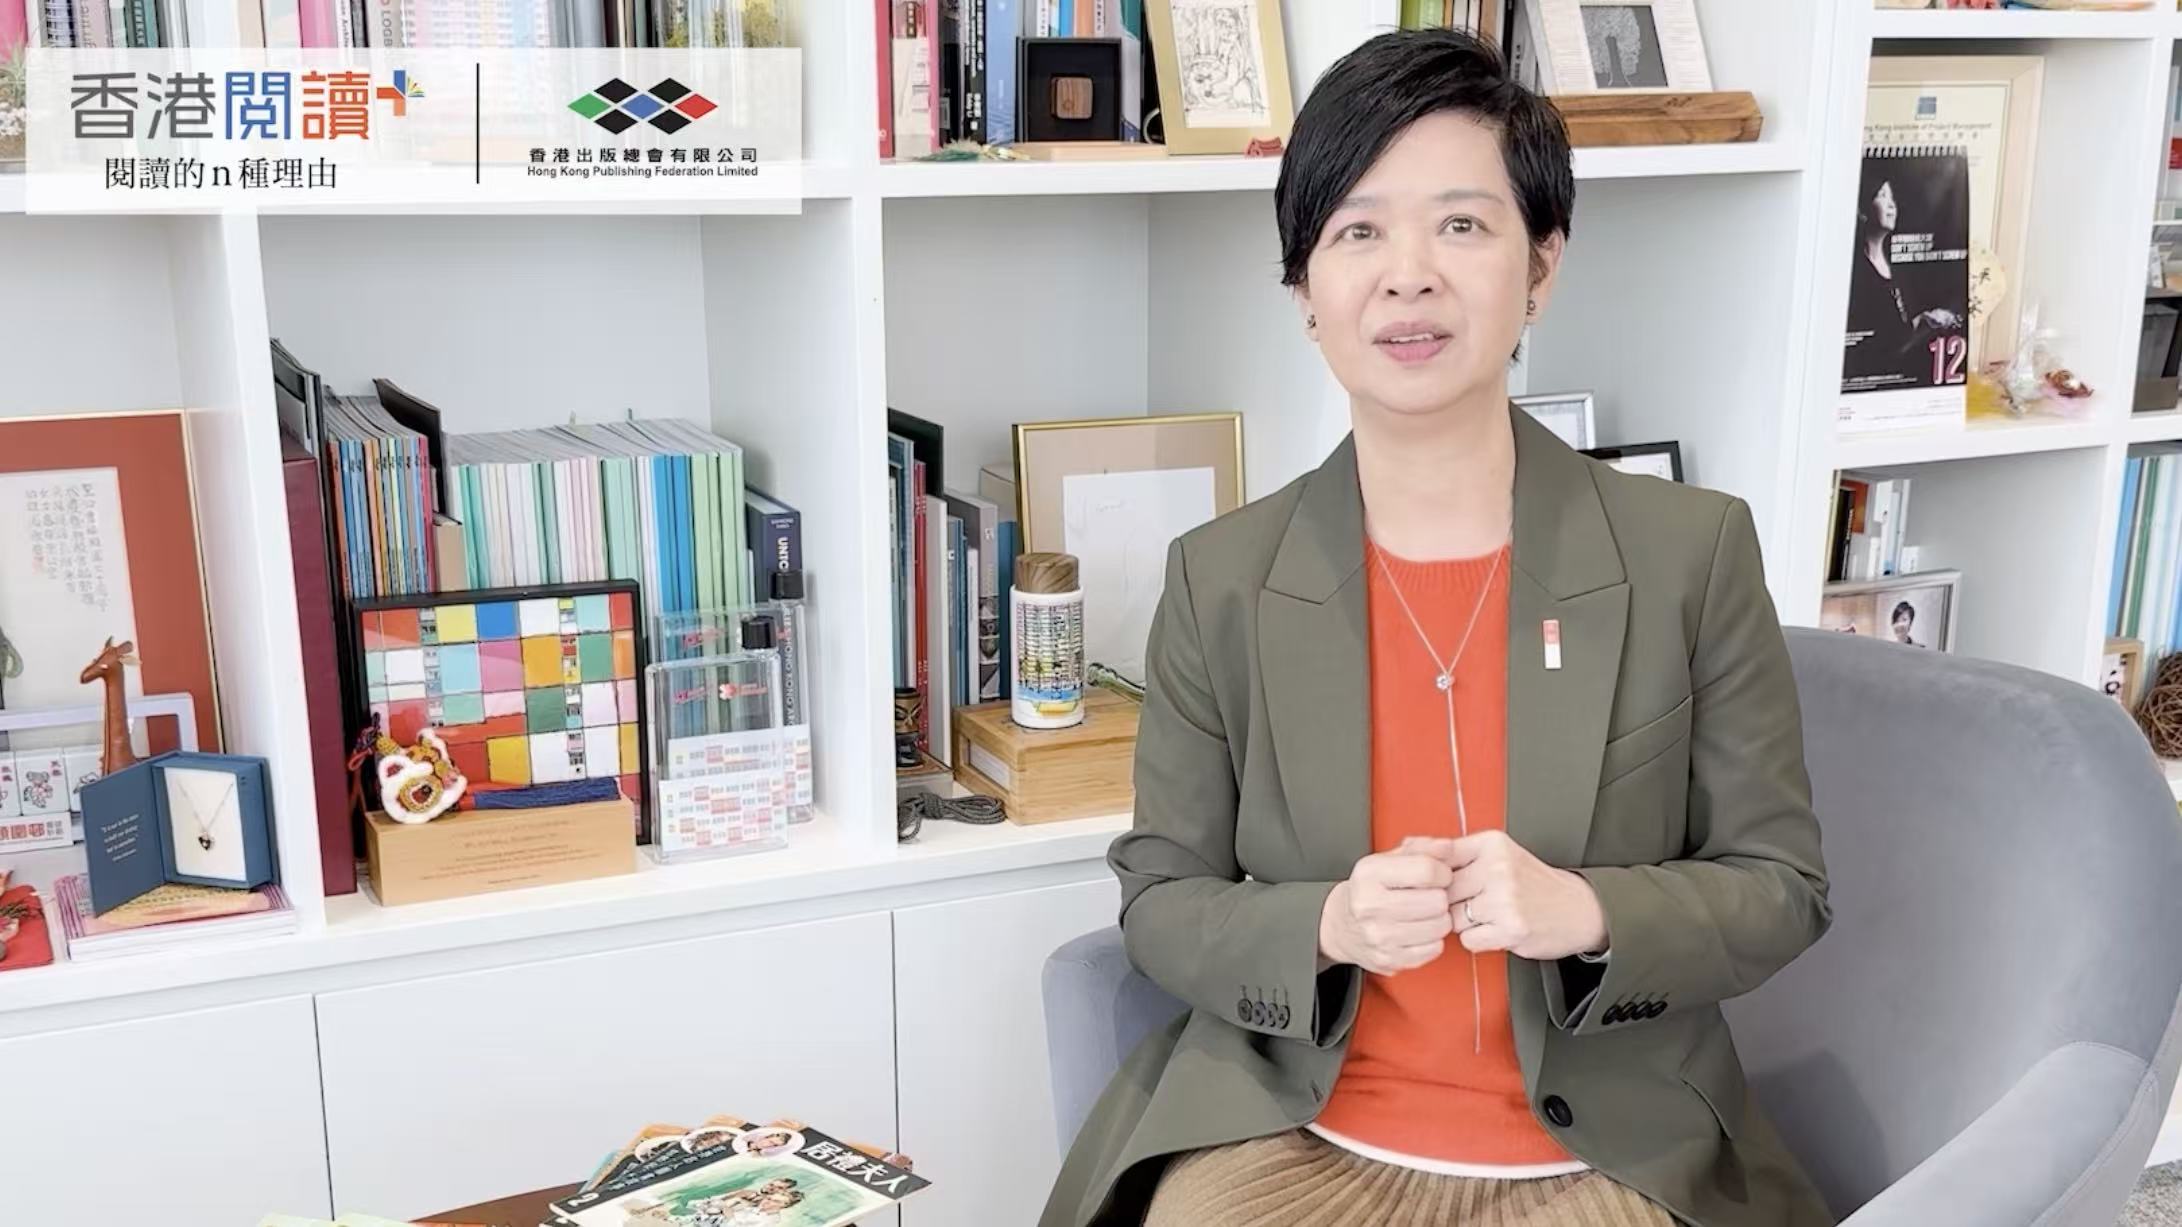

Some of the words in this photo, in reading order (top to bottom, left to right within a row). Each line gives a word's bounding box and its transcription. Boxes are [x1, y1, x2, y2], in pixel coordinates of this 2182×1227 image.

[1929, 335, 1967, 384] 12
[800, 1141, 909, 1194] 居禮夫人
